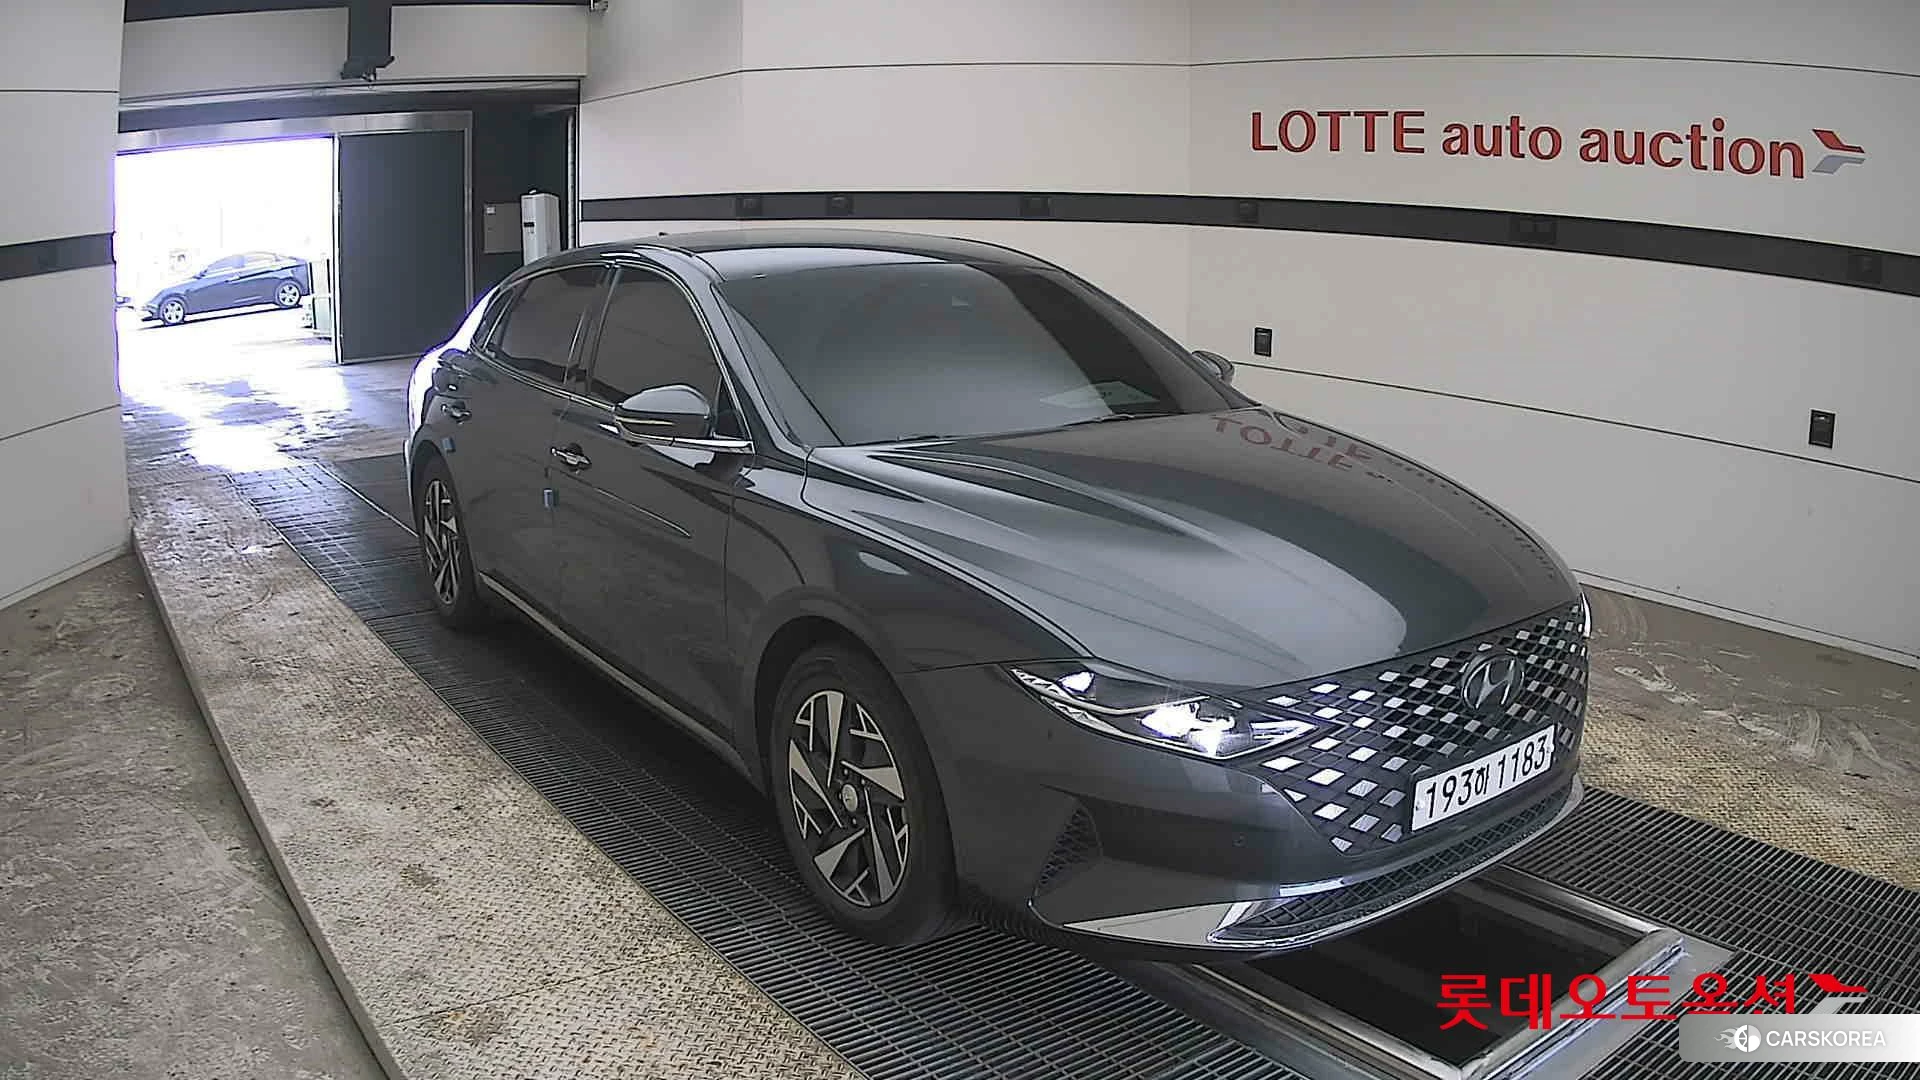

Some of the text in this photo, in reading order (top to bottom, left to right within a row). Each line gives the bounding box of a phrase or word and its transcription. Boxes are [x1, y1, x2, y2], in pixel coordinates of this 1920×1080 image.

[1251, 110, 1804, 179] LOTTE auto auction
[1426, 734, 1548, 819] 193하 1183
